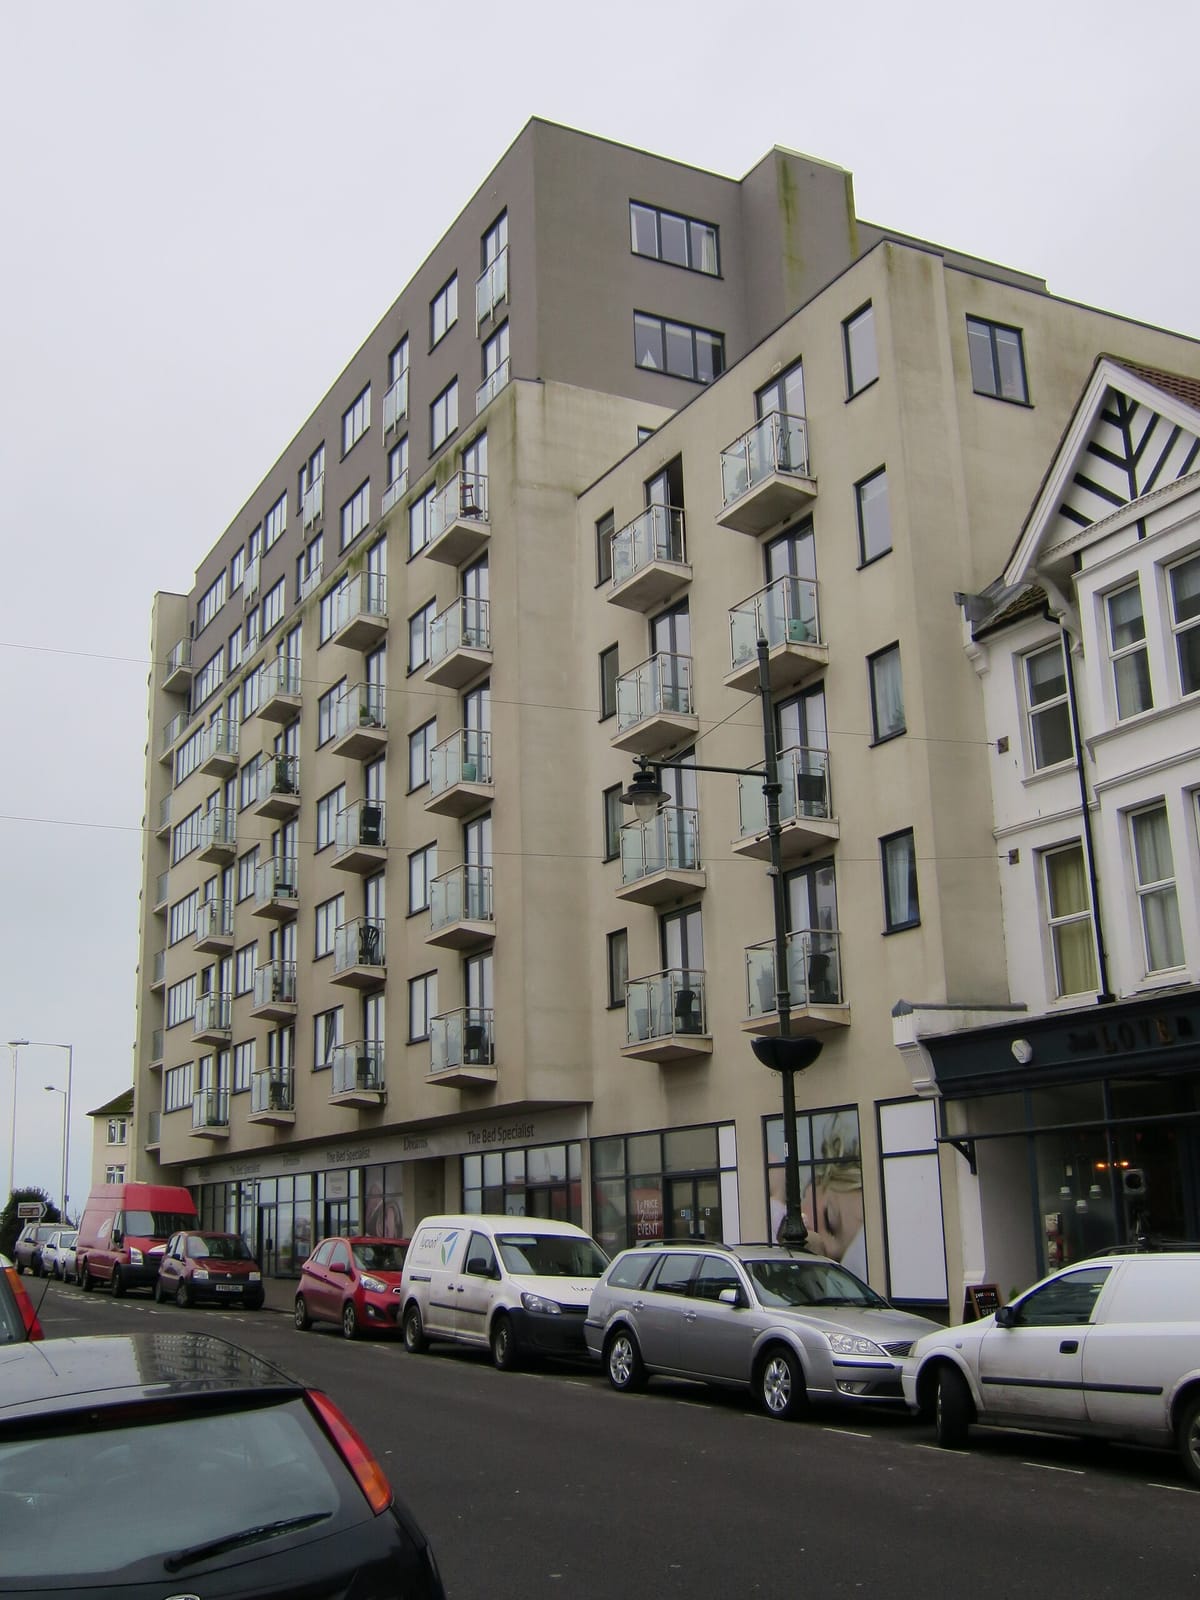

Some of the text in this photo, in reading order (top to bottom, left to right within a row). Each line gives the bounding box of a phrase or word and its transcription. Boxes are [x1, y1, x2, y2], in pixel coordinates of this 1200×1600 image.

[467, 1123, 535, 1144] The Bed Specialist
[644, 1199, 658, 1209] PRICE
[637, 1222, 659, 1236] EVENT
